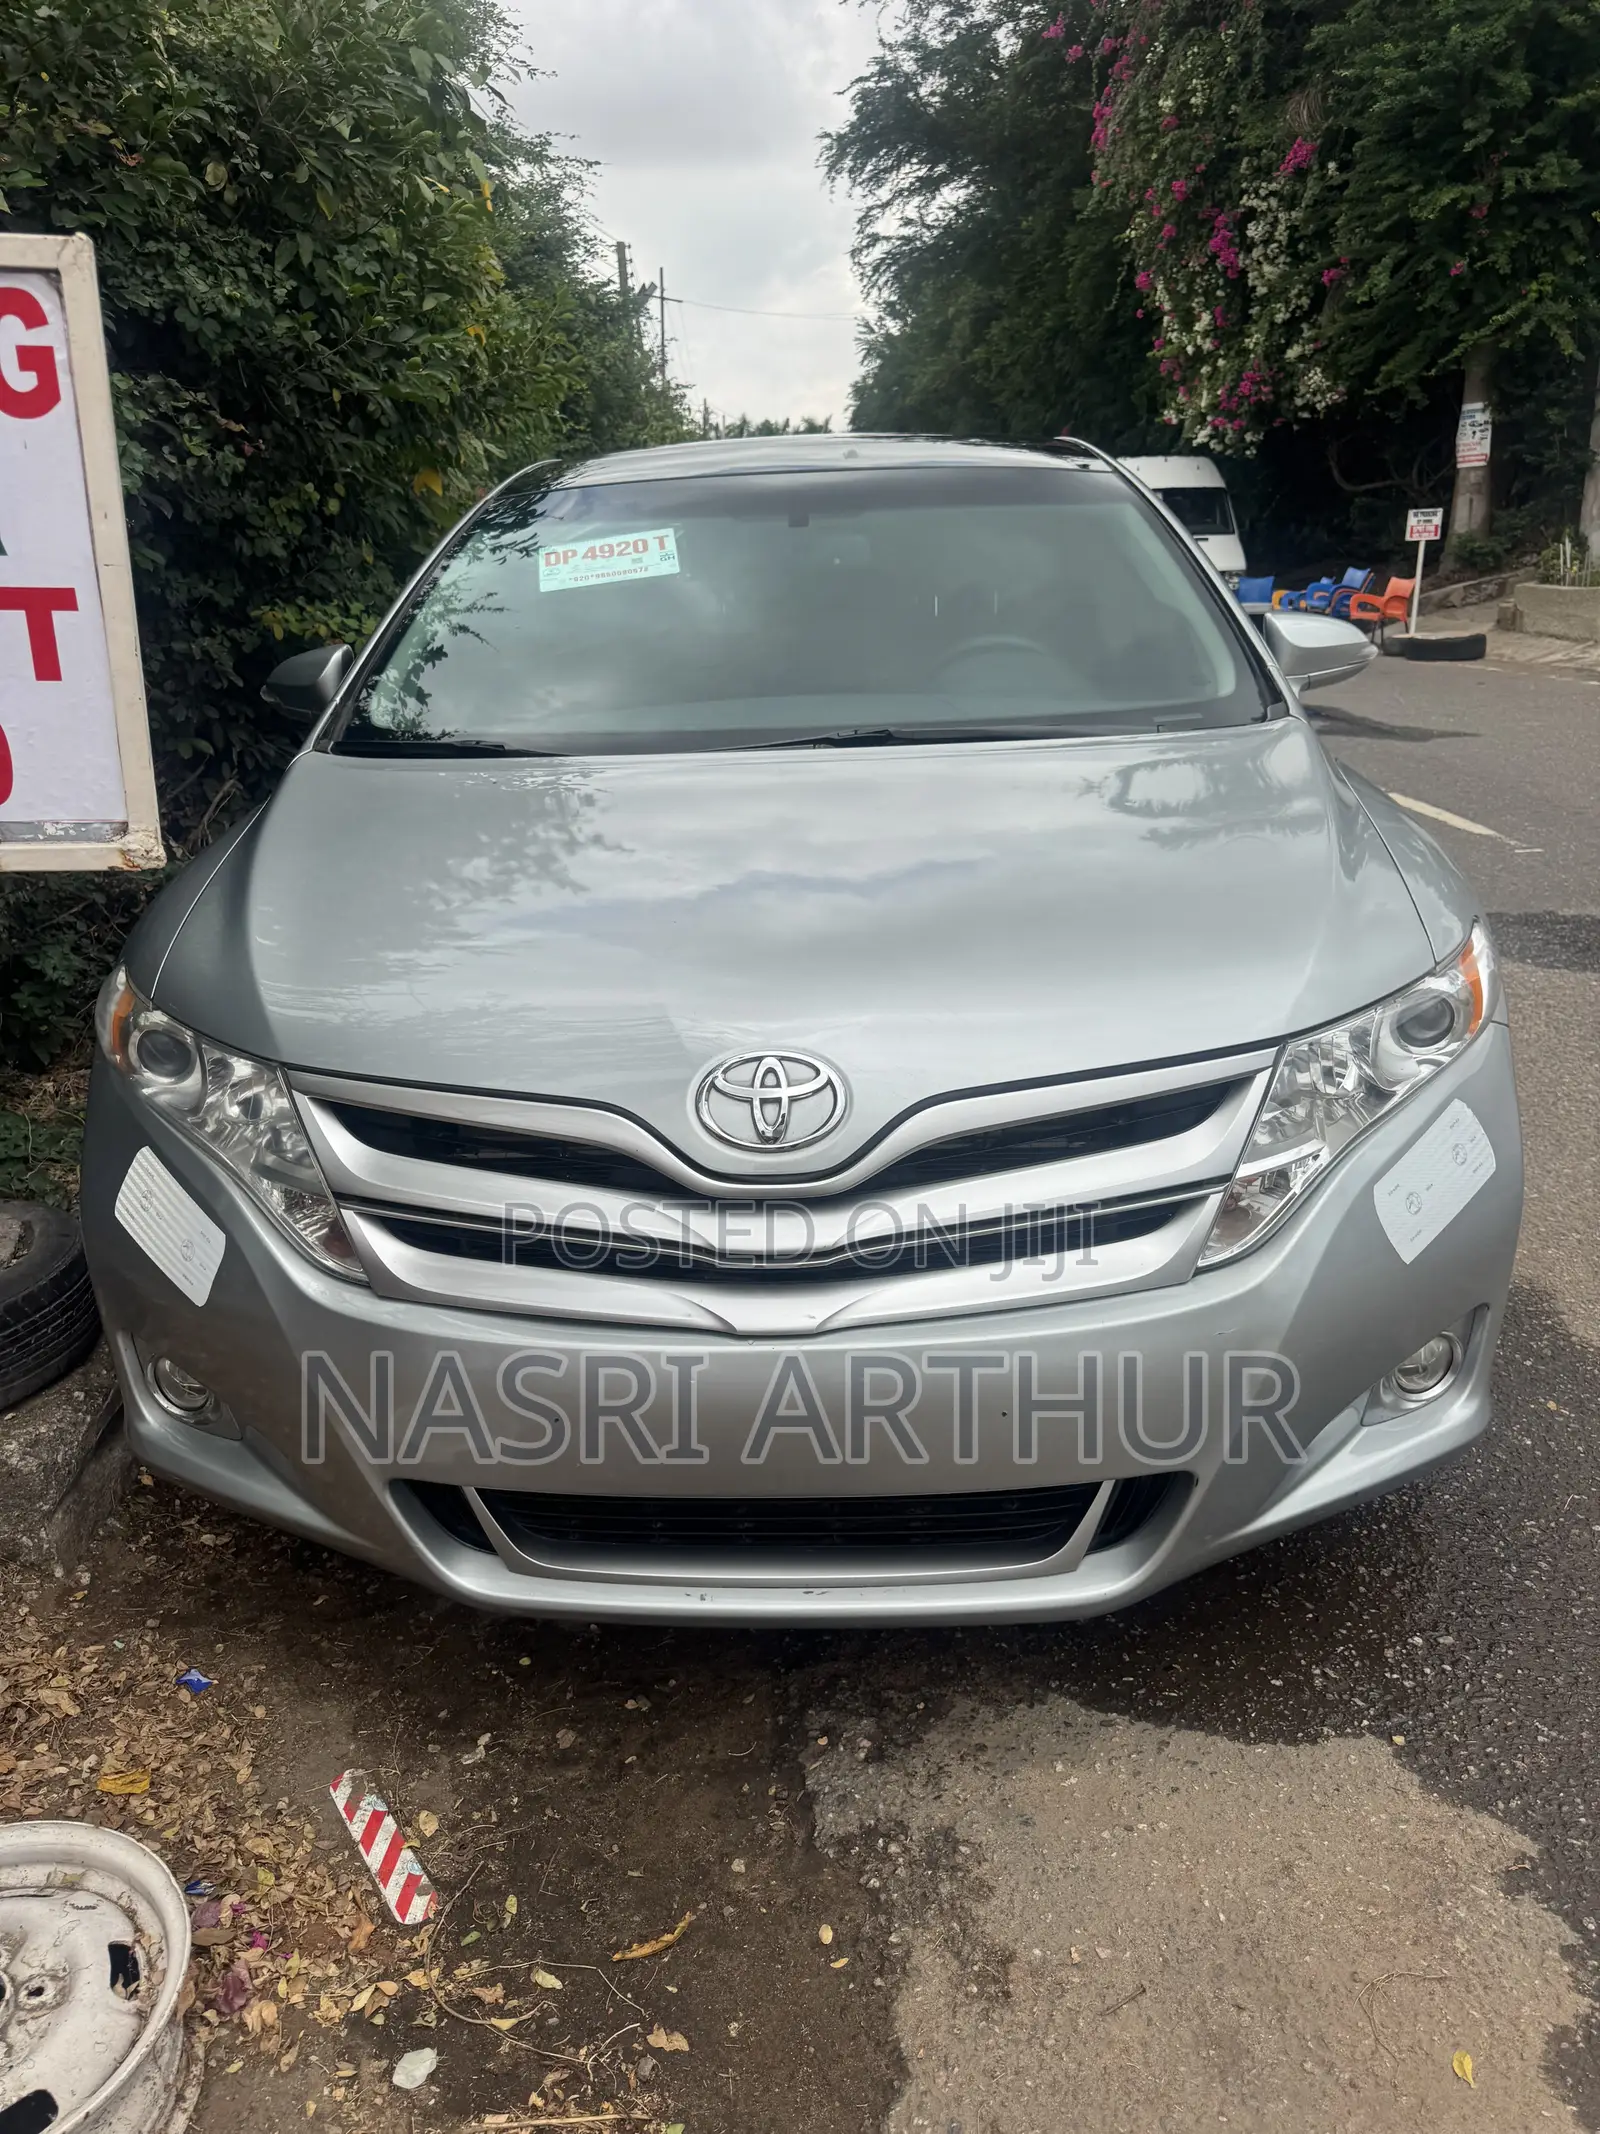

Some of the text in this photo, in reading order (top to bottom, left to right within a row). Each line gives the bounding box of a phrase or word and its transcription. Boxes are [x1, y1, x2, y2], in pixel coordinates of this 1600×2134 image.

[544, 534, 669, 567] DP 4920 T
